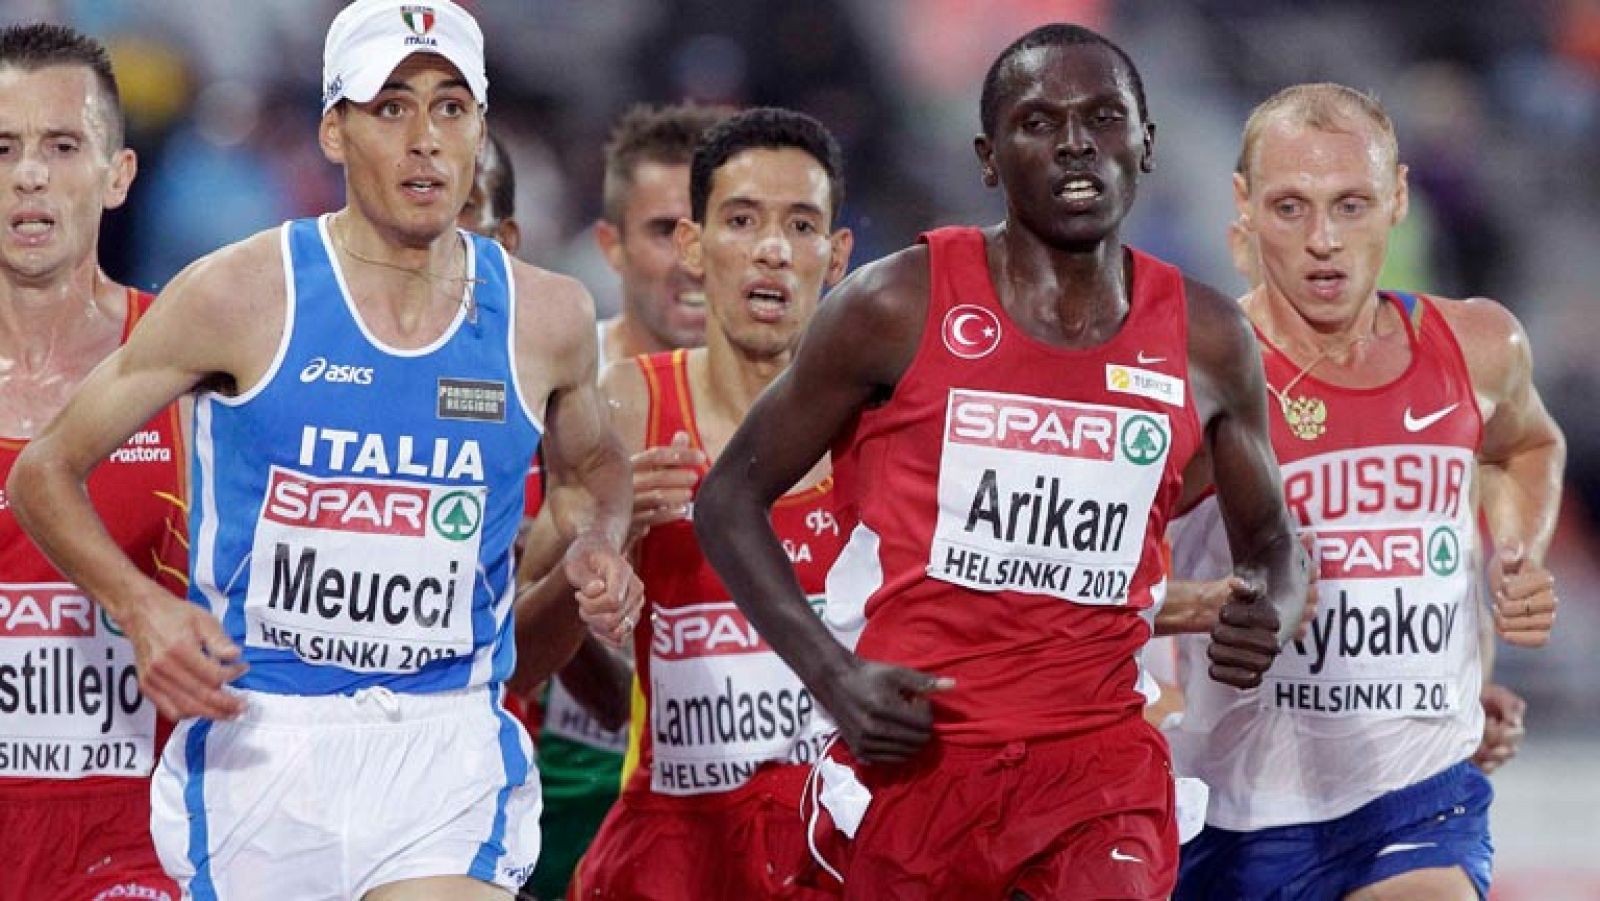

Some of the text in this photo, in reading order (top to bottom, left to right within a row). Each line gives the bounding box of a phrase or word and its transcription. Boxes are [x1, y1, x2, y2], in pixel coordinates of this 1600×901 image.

[324, 364, 374, 384] asics
[300, 425, 484, 481] ITALIA
[955, 402, 1112, 454] SPAR
[271, 481, 425, 529] SPAR
[964, 469, 1128, 551] Arikan
[1284, 454, 1465, 526] RUSSIA
[268, 542, 458, 629] Meucci
[945, 547, 1127, 600] HELSINKI 2012
[260, 623, 388, 669] HELSINKI
[653, 614, 759, 655] SPA
[1294, 588, 1457, 674] ybakov
[1276, 683, 1402, 712] HELSINKI
[81, 741, 137, 771] 2012
[660, 760, 757, 790] HELSIN
